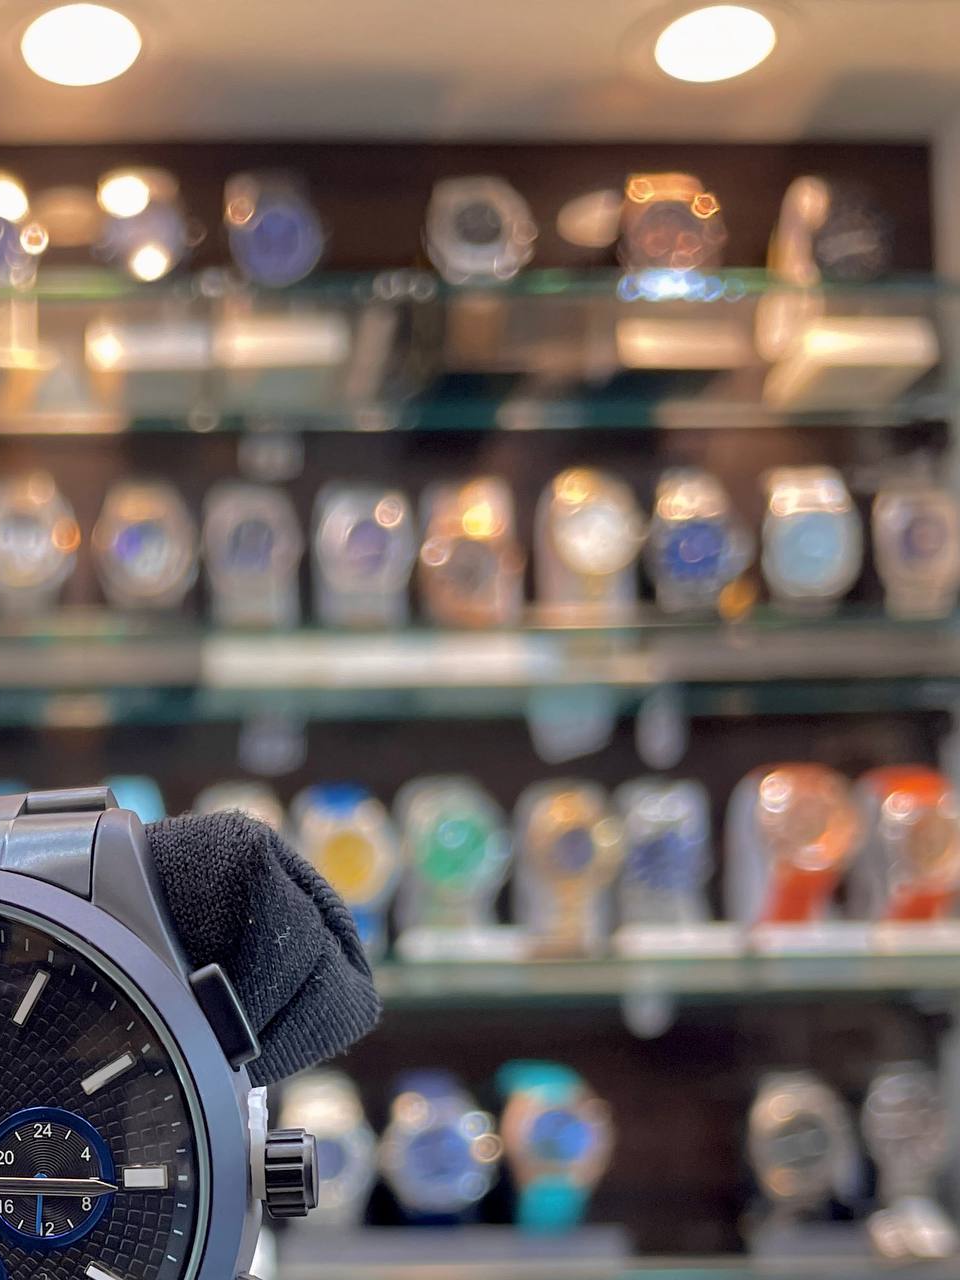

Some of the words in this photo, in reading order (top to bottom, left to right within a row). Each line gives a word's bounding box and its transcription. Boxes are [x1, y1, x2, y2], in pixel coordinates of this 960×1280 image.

[33, 1123, 52, 1138] 24
[80, 1146, 91, 1162] 4
[81, 1196, 92, 1211] 8
